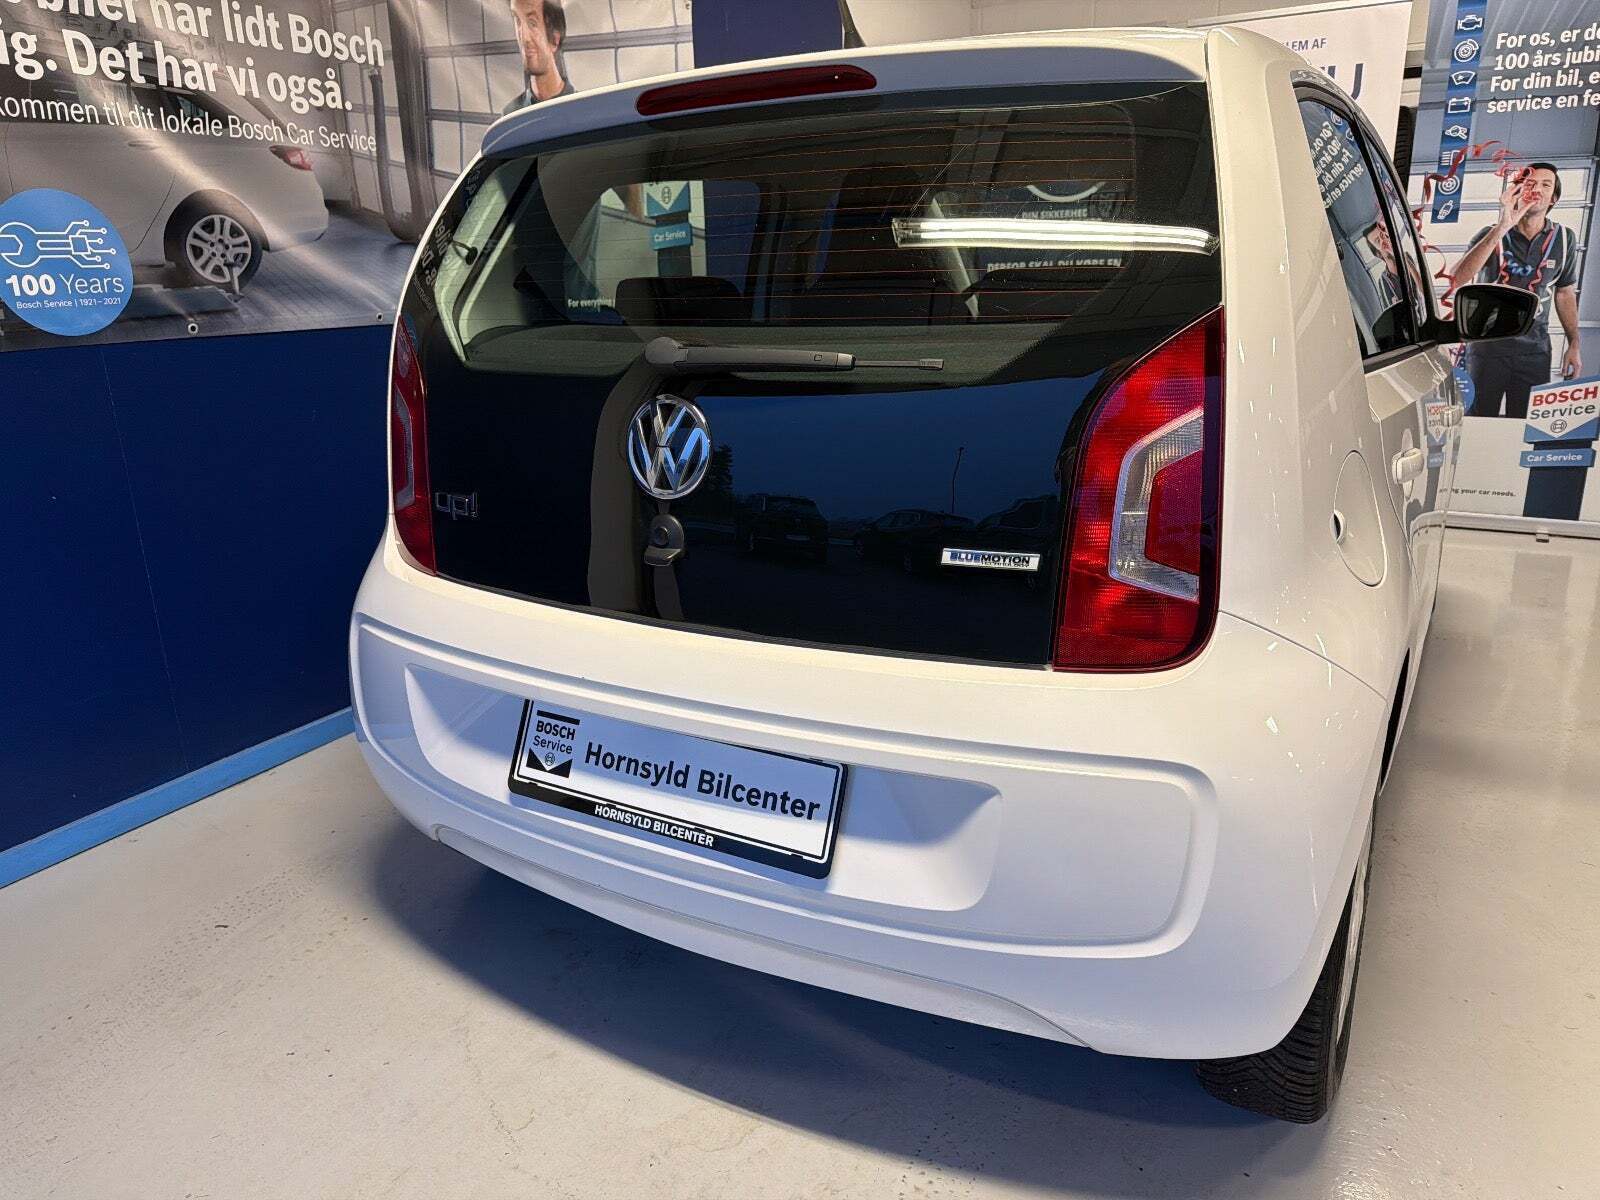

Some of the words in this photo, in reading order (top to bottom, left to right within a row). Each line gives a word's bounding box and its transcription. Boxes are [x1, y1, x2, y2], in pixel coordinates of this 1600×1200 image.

[151, 0, 212, 37] har
[220, 0, 284, 50] lidt
[288, 13, 384, 67] Bosch
[1495, 32, 1527, 49] For
[1529, 32, 1555, 47] os,
[1560, 28, 1580, 43] er
[1286, 40, 1308, 51] EM
[1311, 38, 1327, 50] AF
[1494, 52, 1529, 70] 100
[1532, 49, 1561, 67] års
[62, 29, 146, 84] Det
[154, 40, 219, 92] har
[226, 57, 260, 98] vi
[267, 68, 353, 114] også.
[1490, 75, 1520, 92] For
[1523, 72, 1552, 90] din
[1555, 68, 1584, 87] bil,
[1486, 94, 1552, 113] service
[1555, 94, 1578, 108] en
[103, 102, 125, 127] til
[129, 104, 157, 131] dit
[160, 107, 223, 137] lokale
[228, 115, 284, 143] Bosch
[287, 123, 314, 145] Car
[319, 126, 376, 151] Service
[665, 230, 686, 241] Service
[5, 273, 56, 297] 100
[59, 273, 125, 295] Years
[16, 301, 42, 309] Bosch
[44, 299, 73, 308] Service
[1532, 386, 1599, 406] BOSCH
[1530, 403, 1596, 420] Service
[1526, 454, 1545, 462] Car
[1546, 452, 1582, 462] Service
[949, 551, 1031, 564] BLUEMOTION
[536, 720, 576, 740] BOSCH
[533, 735, 573, 754] Service
[585, 741, 689, 789] Hornsyld
[697, 769, 820, 820] Bilcenter
[594, 804, 652, 830] HORNSYLD
[653, 821, 715, 848] BILCENTER
